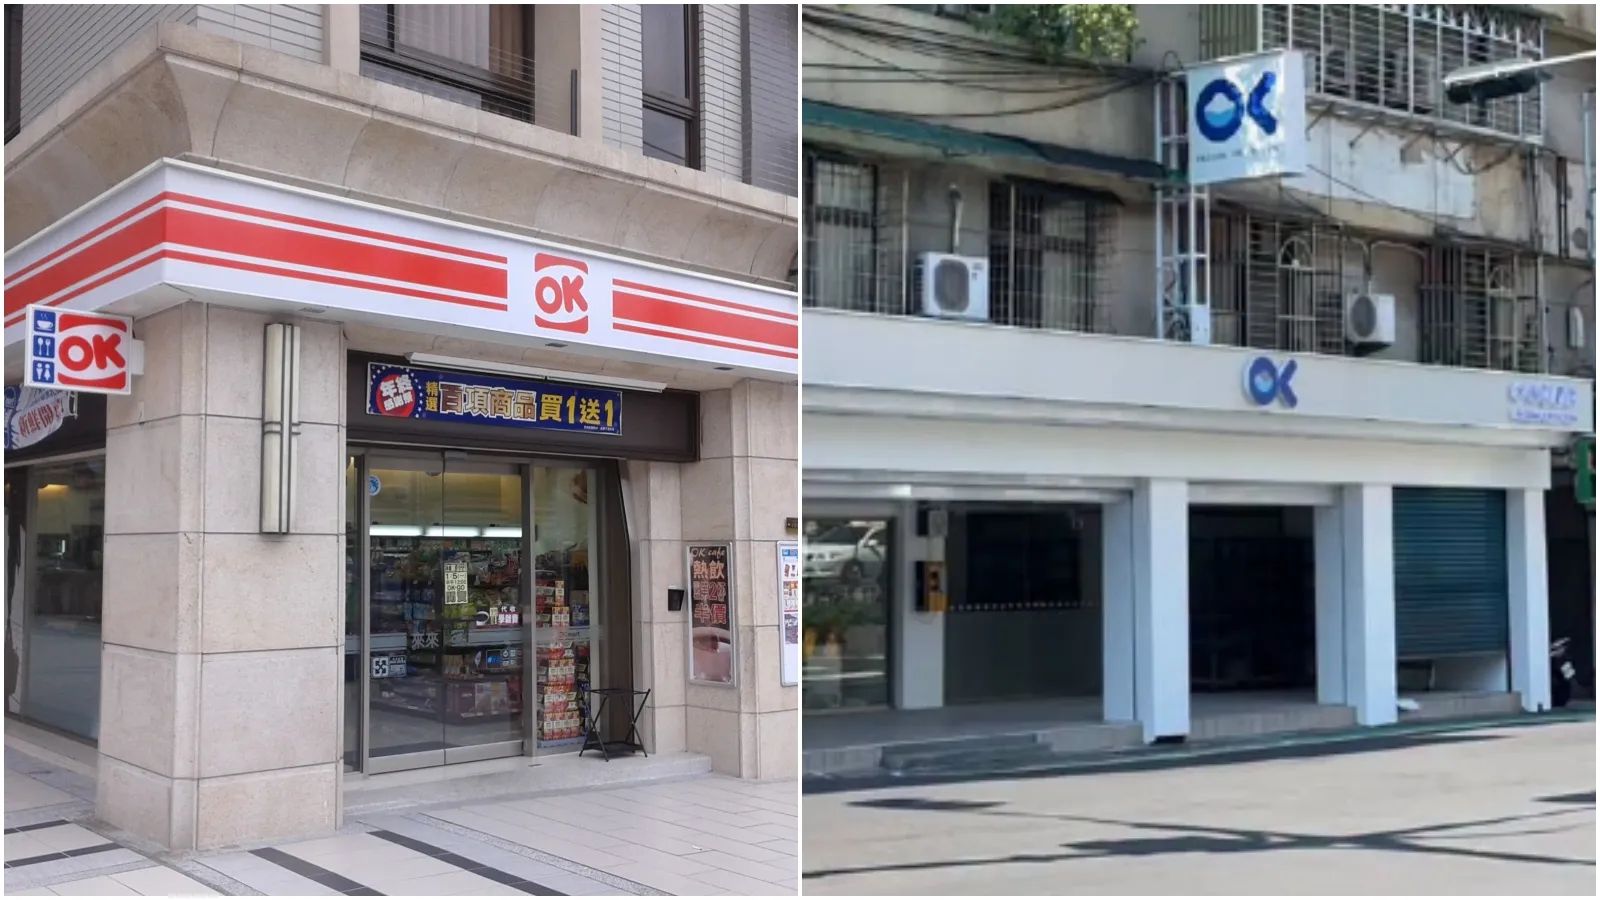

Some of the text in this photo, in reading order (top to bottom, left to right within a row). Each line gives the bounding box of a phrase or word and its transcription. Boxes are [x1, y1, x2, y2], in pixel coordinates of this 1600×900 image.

[1195, 72, 1278, 143] OK
[535, 275, 588, 314] OK
[58, 333, 126, 372] OK
[1248, 356, 1298, 409] OK
[691, 547, 706, 557] OK
[693, 560, 725, 580] 熱飲
[694, 603, 726, 625] 半價
